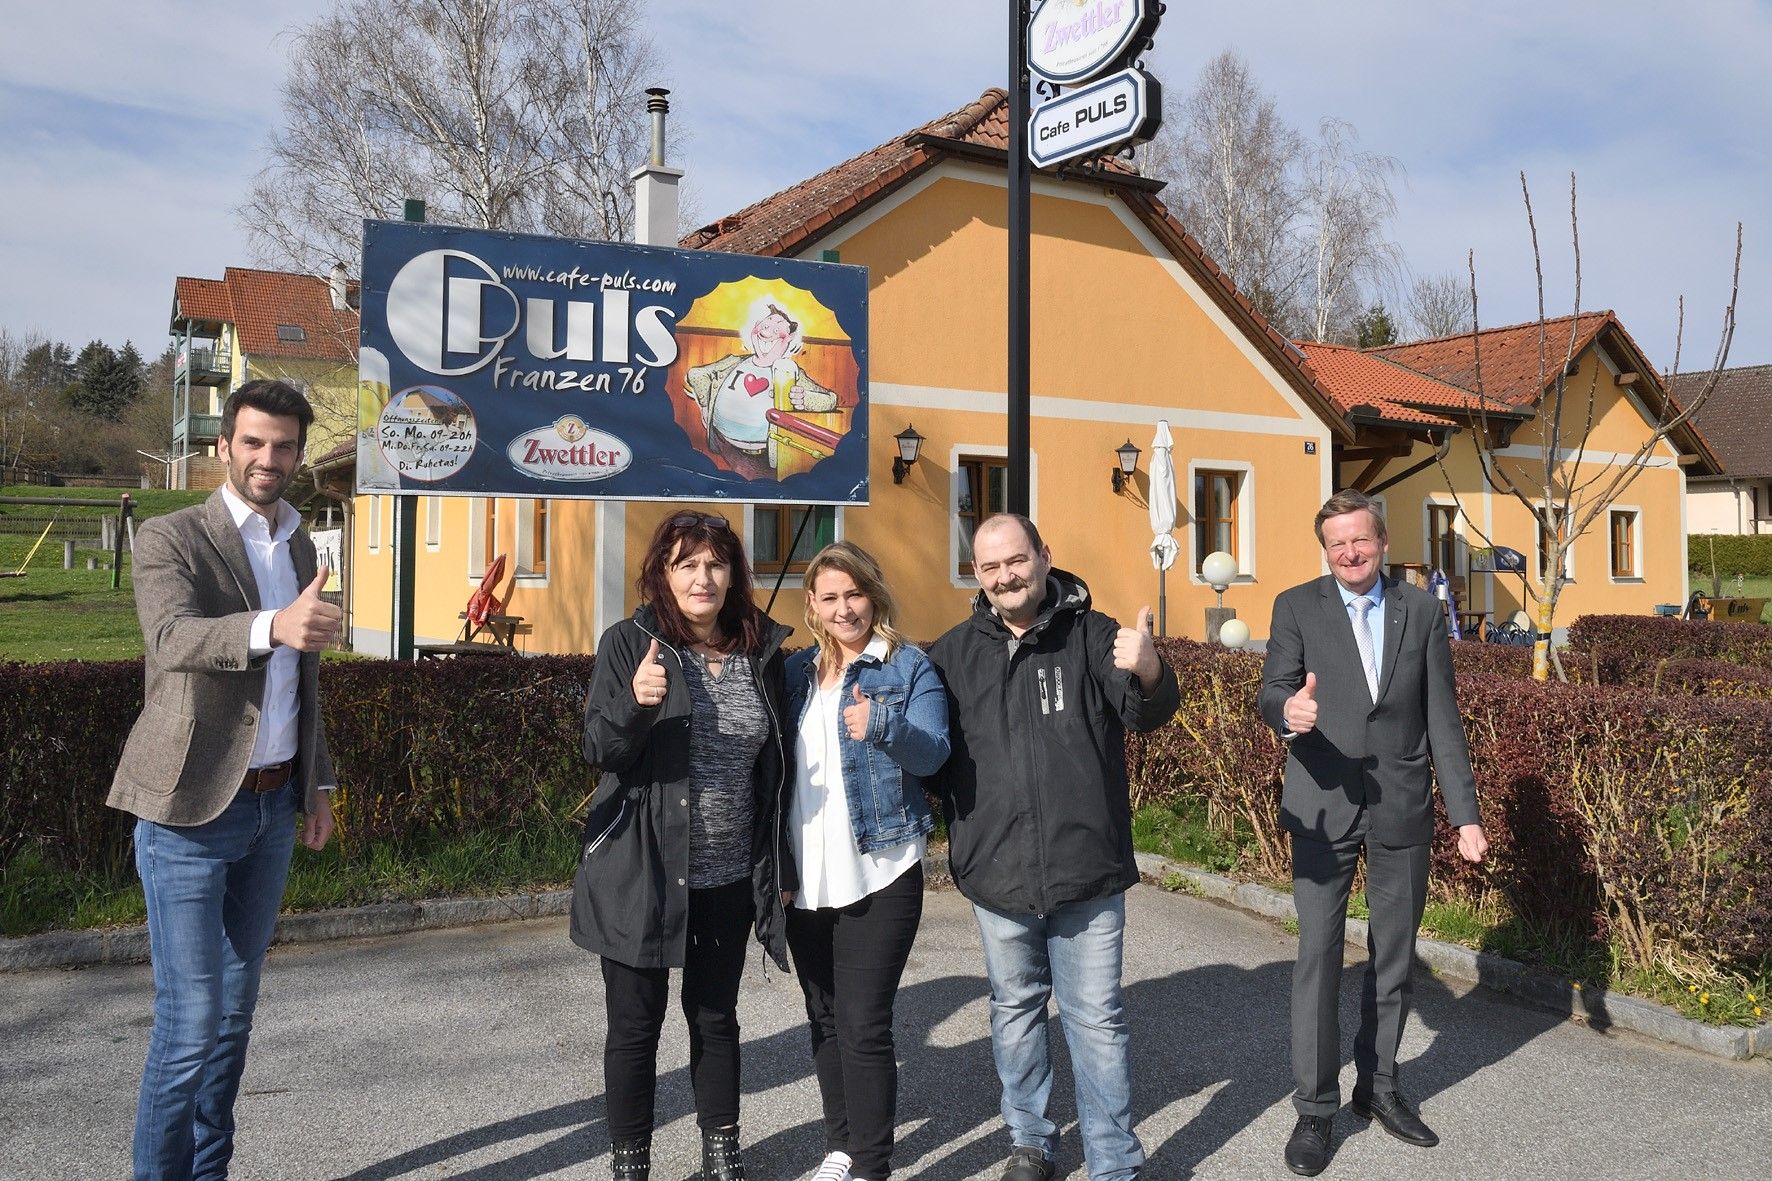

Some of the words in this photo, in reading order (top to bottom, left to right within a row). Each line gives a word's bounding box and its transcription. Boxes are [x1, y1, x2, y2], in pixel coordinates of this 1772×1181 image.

[1043, 1, 1124, 55] Zwettler
[1040, 120, 1070, 142] Cafe
[1075, 93, 1127, 129] PULS
[503, 263, 677, 296] www.cafe-puls.com
[494, 356, 611, 393] Franzen
[617, 366, 647, 394] 76
[381, 426, 400, 439] So.
[404, 426, 426, 439] Mo.
[430, 429, 472, 441] 09-20h
[439, 445, 473, 453] 09-22h
[399, 461, 412, 471] Di.
[415, 456, 458, 469] Ruhetag!
[522, 438, 621, 467] Zwettler
